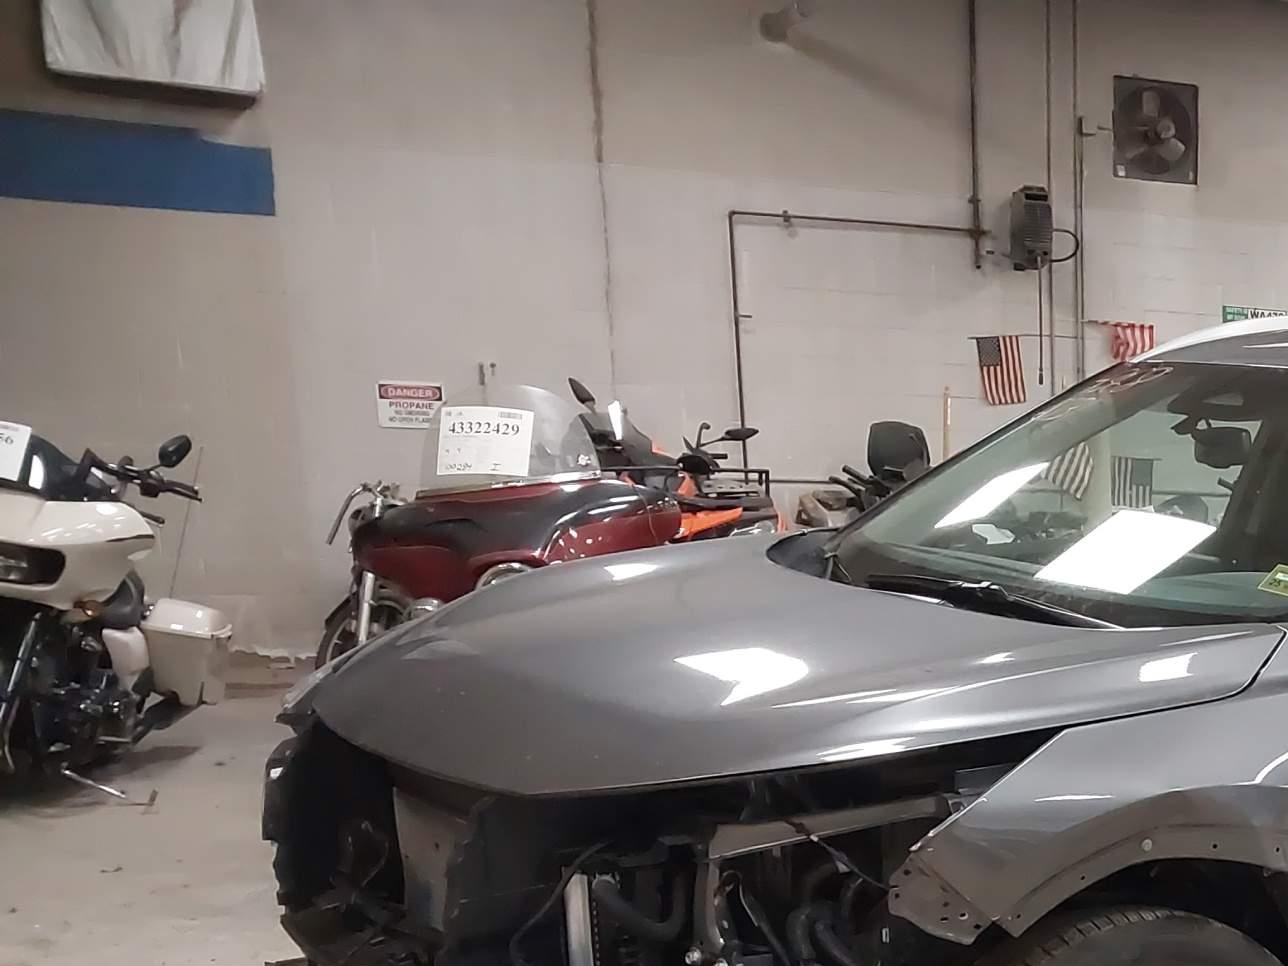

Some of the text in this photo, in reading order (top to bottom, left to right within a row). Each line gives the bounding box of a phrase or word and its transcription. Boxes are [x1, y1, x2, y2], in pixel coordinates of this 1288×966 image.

[387, 387, 433, 398] DANGER
[388, 400, 435, 410] PROPANE
[448, 421, 520, 436] 43322429
